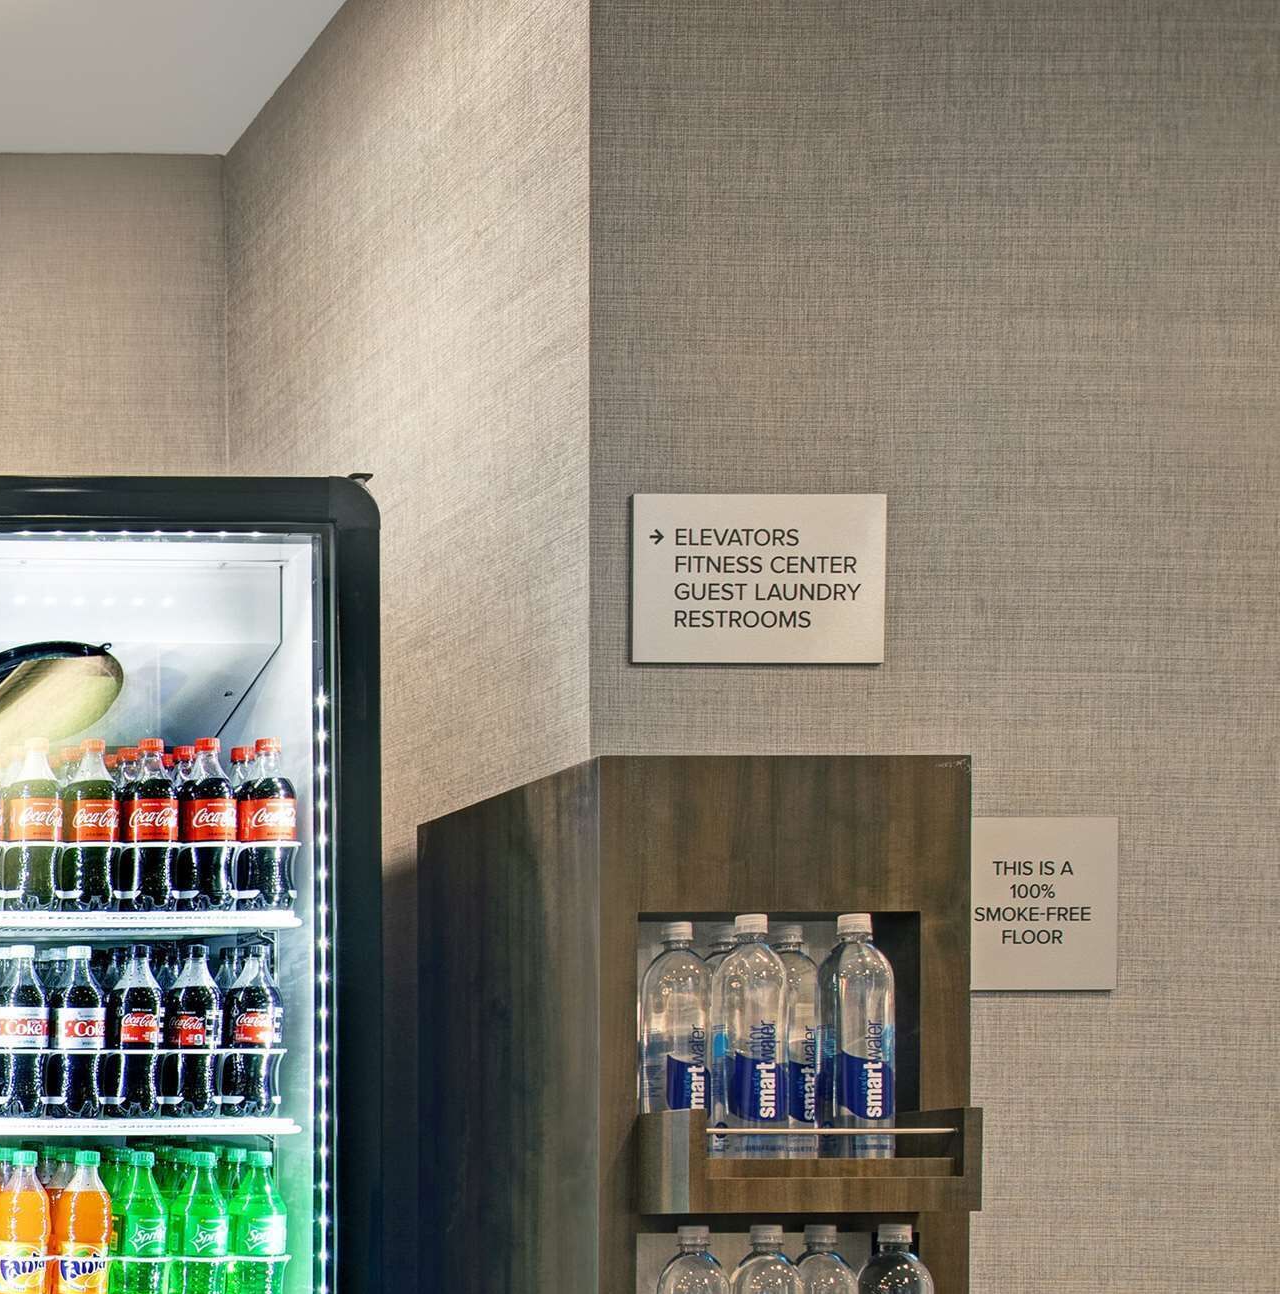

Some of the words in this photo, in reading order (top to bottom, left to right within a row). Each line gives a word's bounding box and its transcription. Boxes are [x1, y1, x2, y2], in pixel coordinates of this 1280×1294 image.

[674, 528, 800, 547] ELEVATORS
[674, 555, 763, 574] FITNESS
[770, 555, 857, 574] CENTER
[674, 582, 748, 601] GUEST
[754, 583, 862, 601] LAUNDRY
[673, 610, 812, 628] RESTROOMS
[993, 860, 1033, 876] THIS
[1039, 860, 1055, 876] IS
[1060, 860, 1074, 876] A
[1009, 883, 1056, 899] 100%
[974, 906, 1092, 922] SMOKE-FREE
[1001, 929, 1064, 945] FLOOR
[5, 1020, 43, 1035] Coke
[121, 1012, 158, 1027] Coca-Cola
[687, 1023, 706, 1110] martwater
